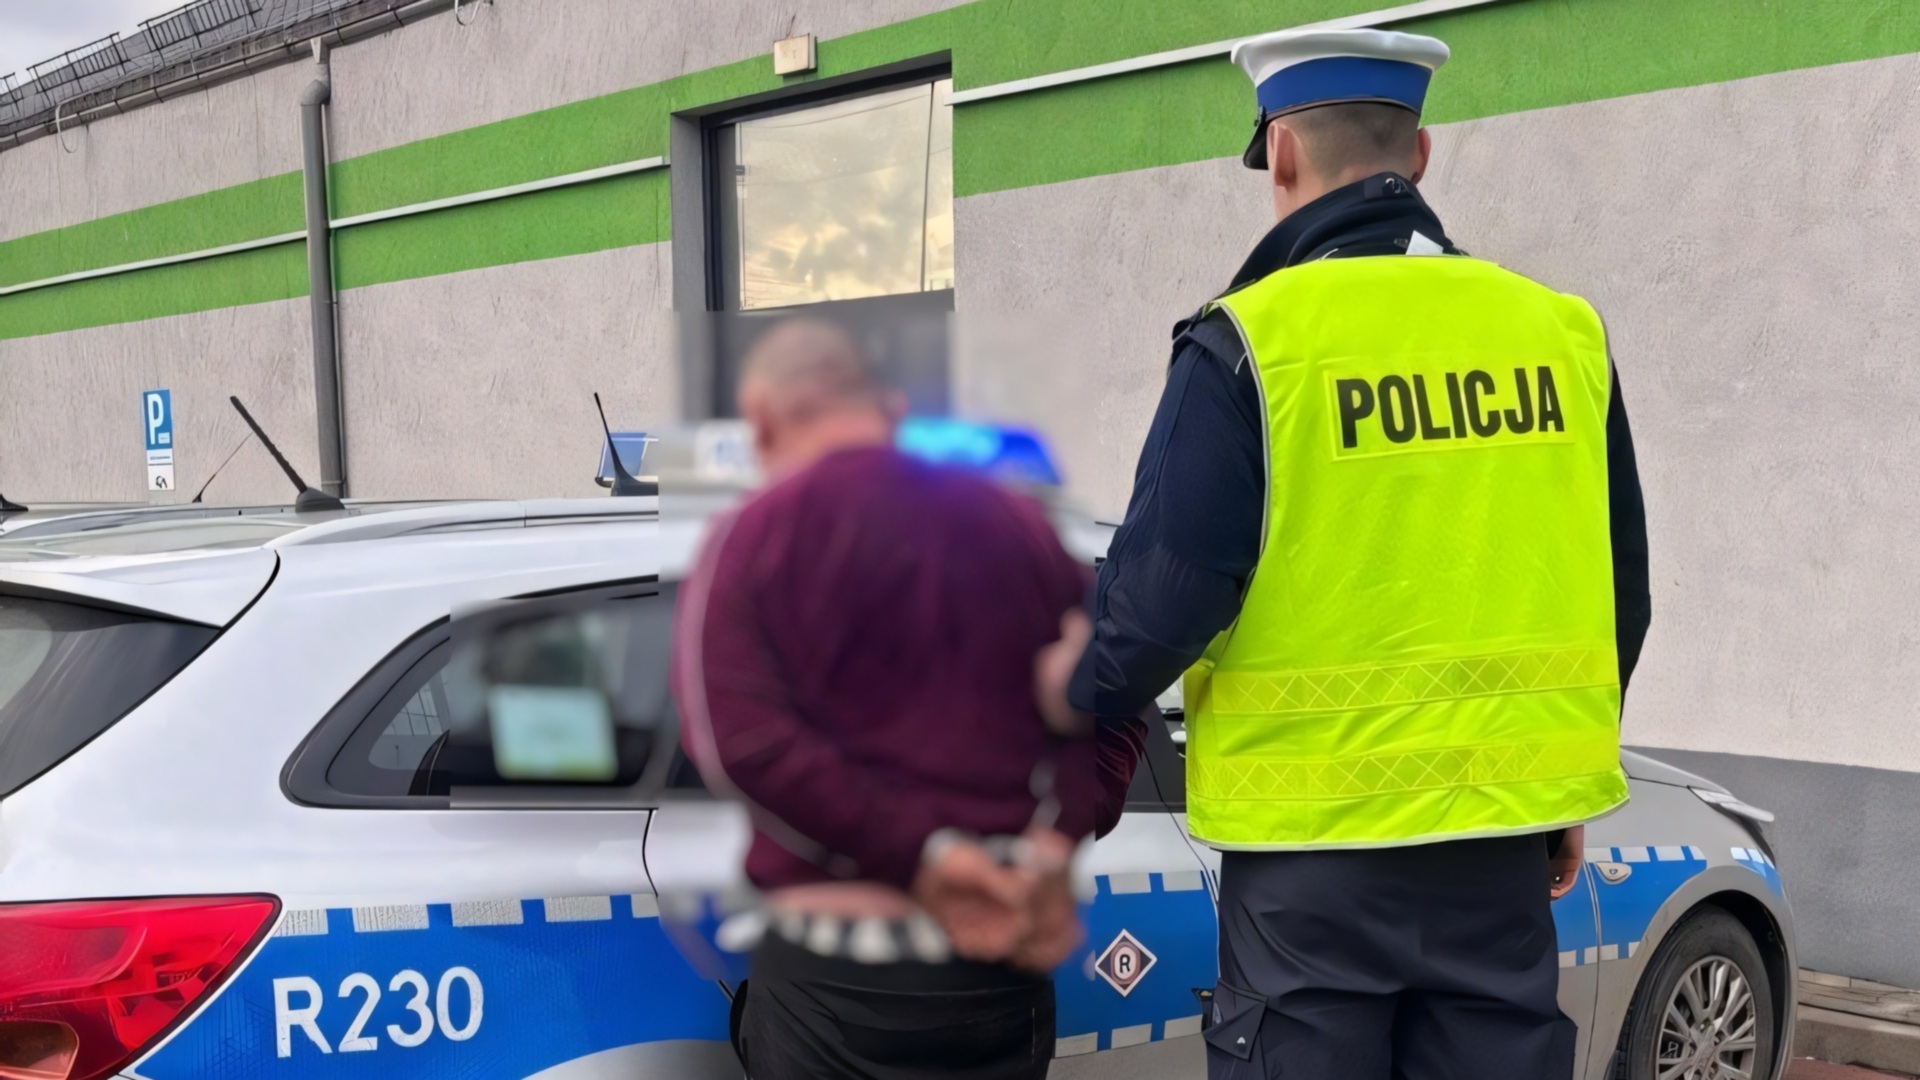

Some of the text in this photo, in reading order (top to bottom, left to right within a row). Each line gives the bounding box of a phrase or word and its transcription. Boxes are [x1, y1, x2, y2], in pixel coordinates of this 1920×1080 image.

[147, 393, 164, 445] P
[1336, 366, 1565, 449] POLICJA
[1119, 953, 1131, 973] R
[273, 966, 484, 1058] R230
